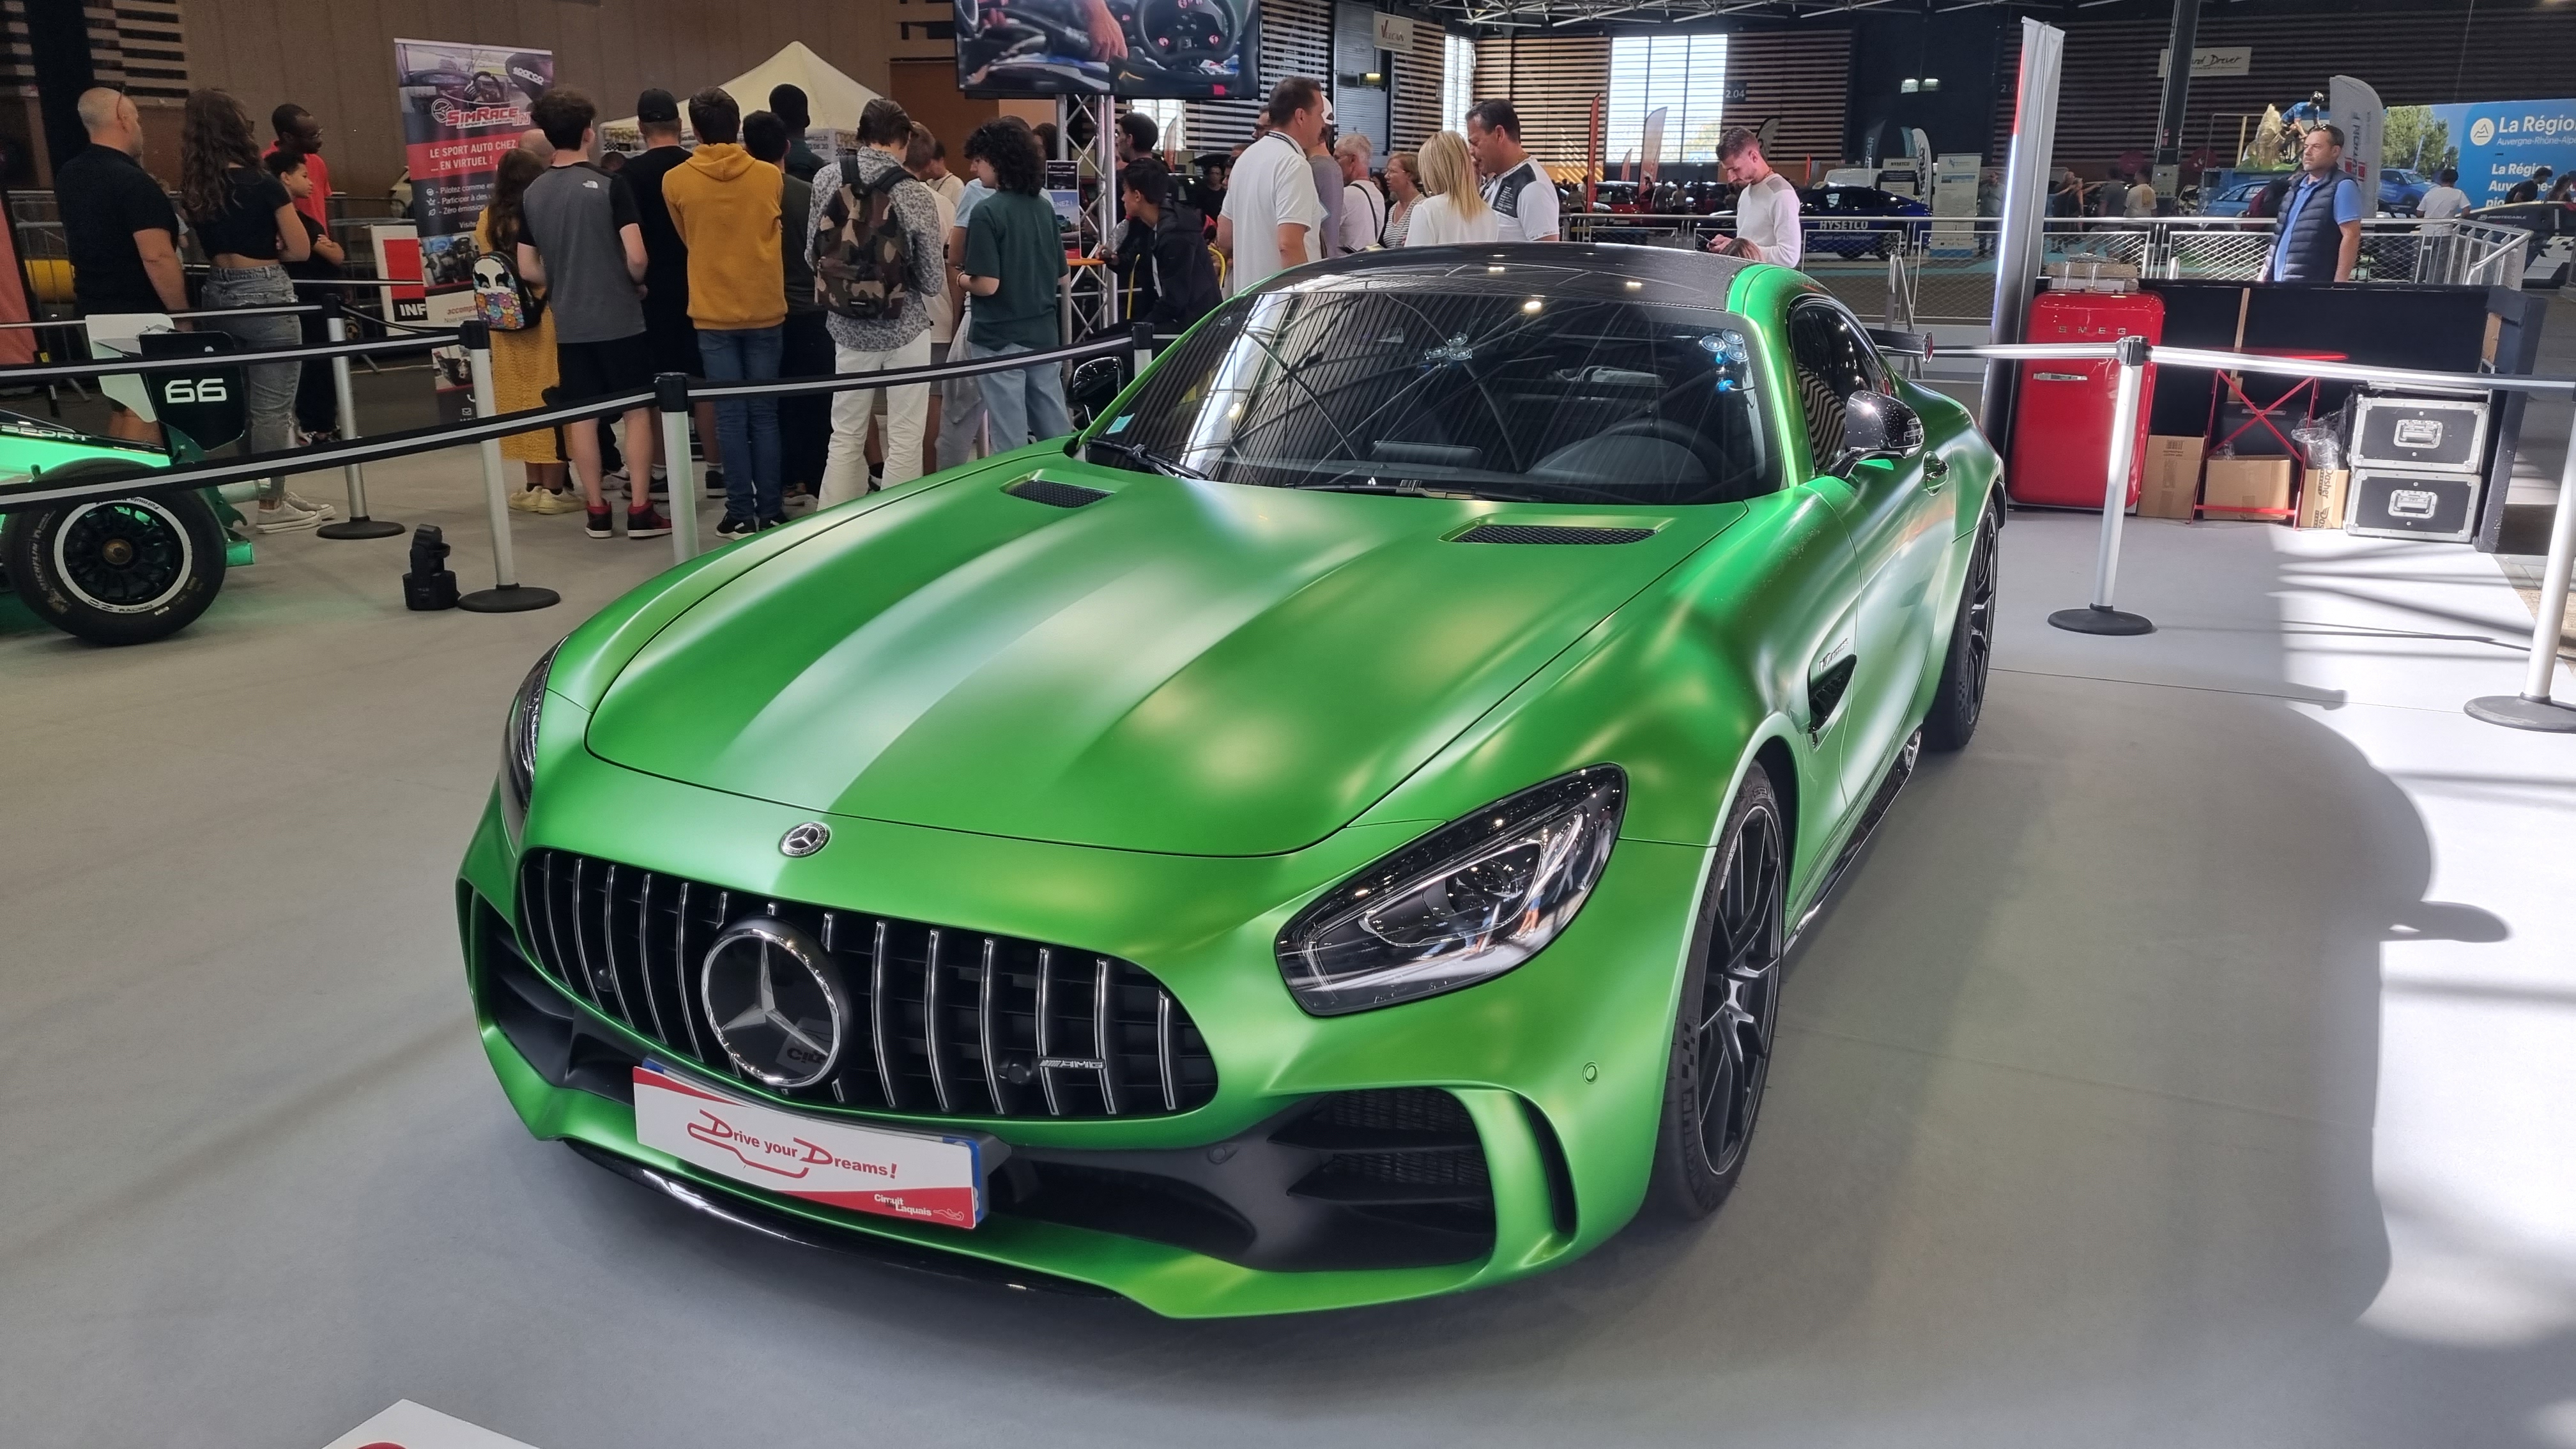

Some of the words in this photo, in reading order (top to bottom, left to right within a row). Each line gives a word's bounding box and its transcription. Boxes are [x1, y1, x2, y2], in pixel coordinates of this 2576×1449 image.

[512, 66, 544, 84] sparco
[1726, 89, 1745, 98] 2.04
[2499, 116, 2518, 134] La
[2522, 114, 2576, 135] Régio
[429, 148, 440, 159] LE
[441, 144, 470, 158] SPORT
[471, 142, 494, 153] AUTO
[495, 139, 517, 151] CHEZ
[440, 160, 451, 171] EN
[452, 157, 488, 169] VIRTUEL
[2492, 164, 2506, 175] La
[2508, 162, 2551, 178] Régi
[461, 183, 486, 192] comme
[441, 195, 470, 205] Participer
[443, 206, 457, 215] Zéro
[2058, 326, 2126, 335] SMEG
[165, 378, 227, 404] 66
[2322, 468, 2334, 499] Dasher
[118, 604, 153, 612] RACING
[1059, 1059, 1103, 1069] AMG
[687, 1108, 760, 1148] Drive
[763, 1139, 798, 1159] your
[792, 1137, 897, 1179] Dreams!
[895, 1204, 932, 1216] Laquais
